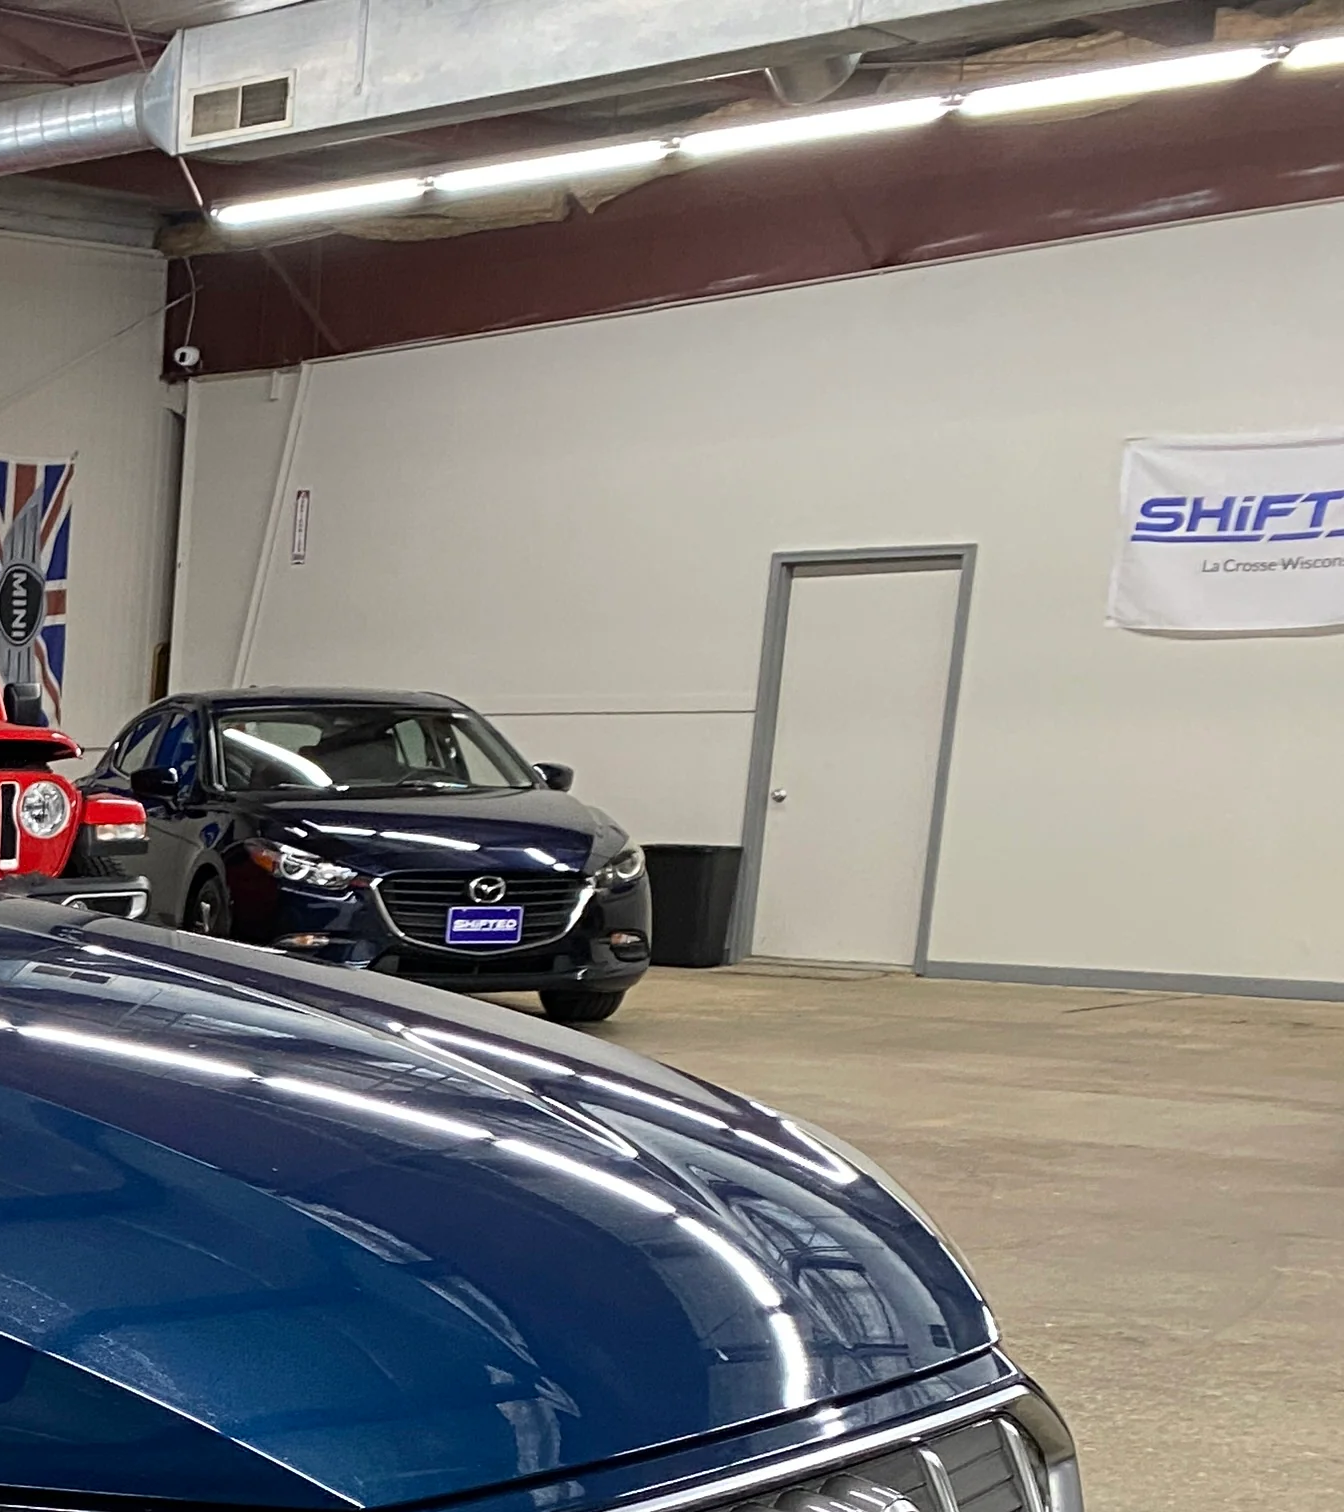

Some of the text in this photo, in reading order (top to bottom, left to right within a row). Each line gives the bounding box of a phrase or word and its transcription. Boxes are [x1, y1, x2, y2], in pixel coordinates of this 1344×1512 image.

[1201, 559, 1220, 573] La
[1223, 558, 1277, 573] Crosse
[10, 572, 28, 638] MINI
